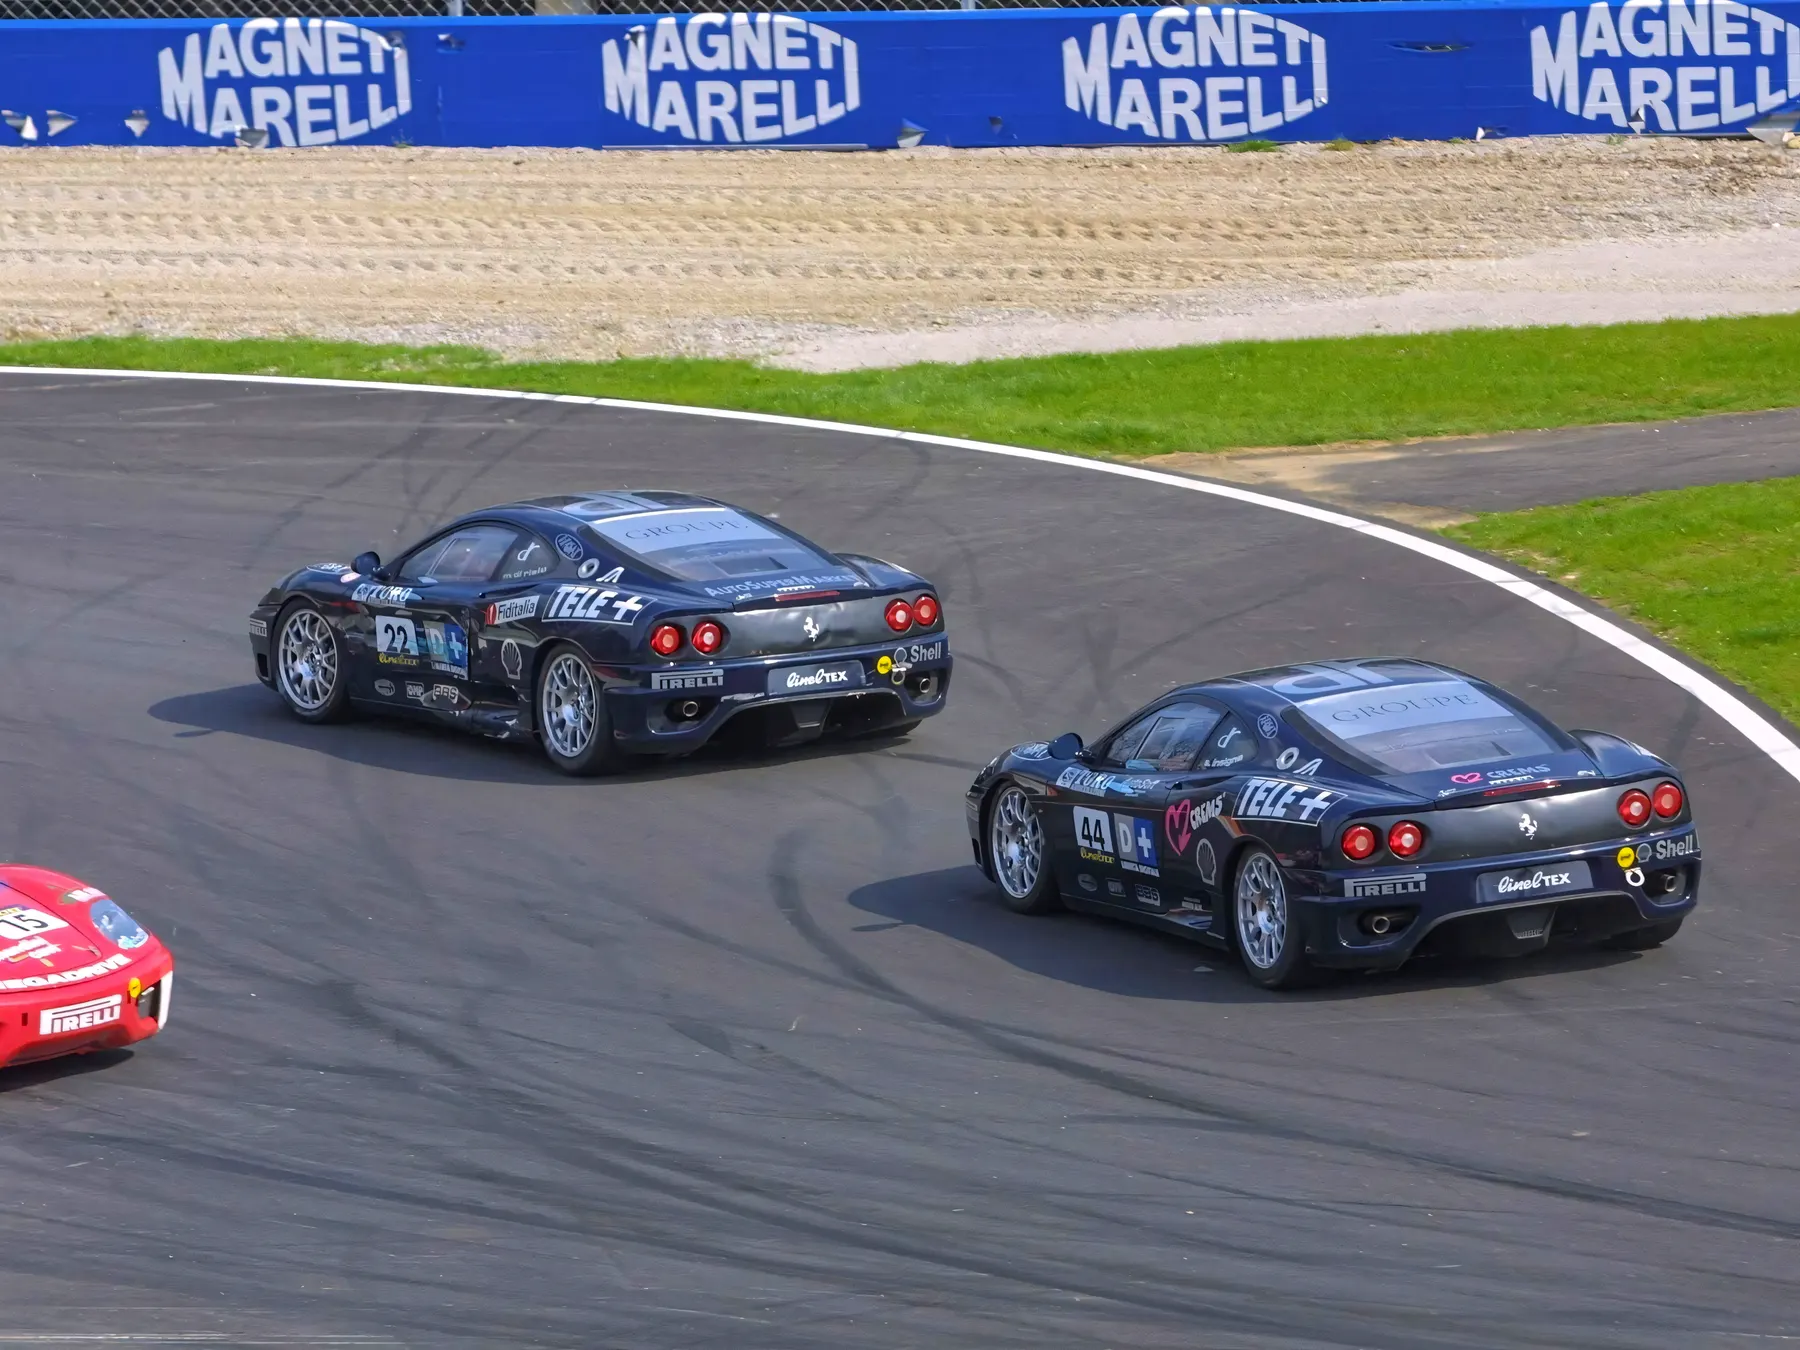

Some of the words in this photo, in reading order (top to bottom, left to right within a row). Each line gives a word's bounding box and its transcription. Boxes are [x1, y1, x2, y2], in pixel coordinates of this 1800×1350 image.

[497, 601, 536, 620] Fiditalia
[384, 624, 410, 653] 22
[910, 642, 942, 663] Shell
[651, 668, 724, 690] PIRELLI
[1332, 693, 1479, 722] GROUPE
[1081, 816, 1105, 850] 44
[1656, 834, 1694, 861] Shell
[1343, 873, 1427, 898] PIRELLI
[39, 994, 122, 1035] PIRELLI
